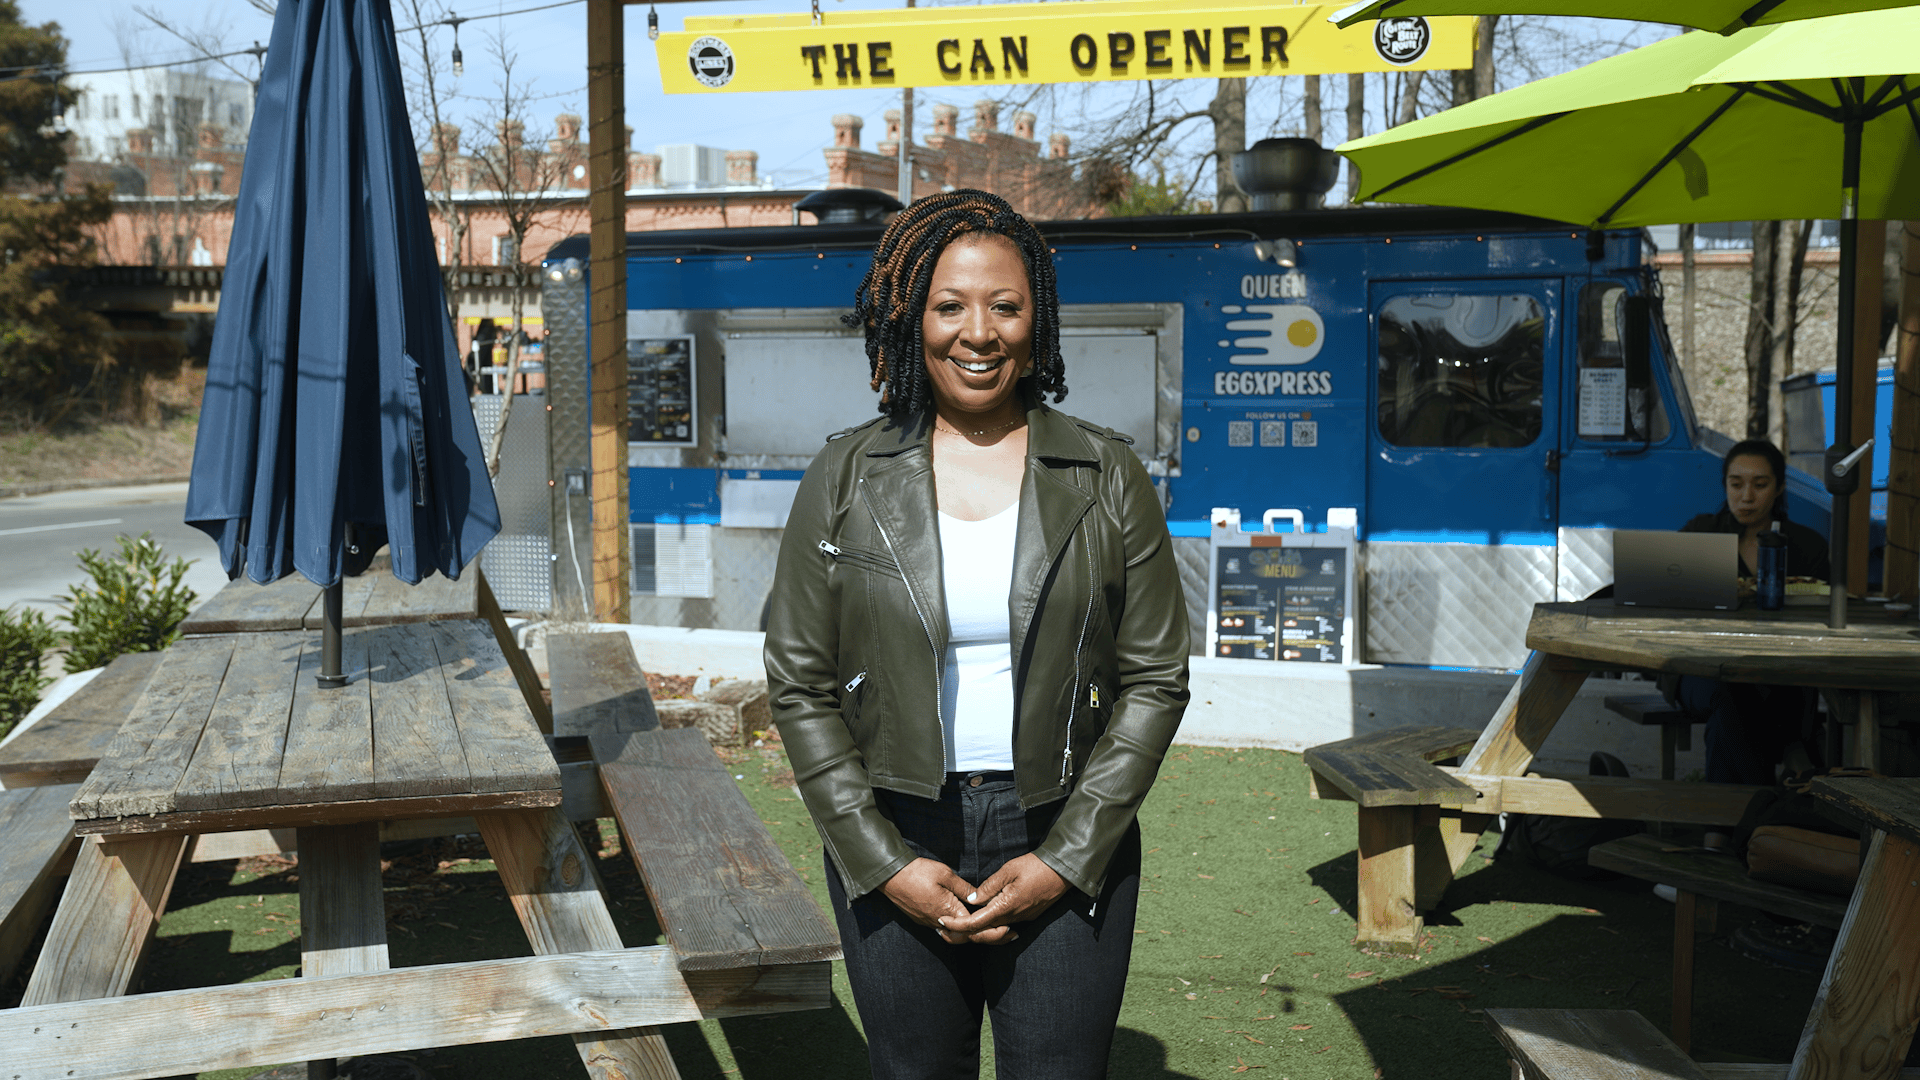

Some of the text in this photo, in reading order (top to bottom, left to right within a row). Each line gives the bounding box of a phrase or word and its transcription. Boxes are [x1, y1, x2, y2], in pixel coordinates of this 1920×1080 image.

[1397, 30, 1419, 41] BELT
[800, 26, 1290, 80] THE CAN OPENER
[1391, 40, 1417, 54] ROUTE
[1241, 274, 1307, 299] QUEEN
[1214, 371, 1332, 396] EGGXPRESS
[1245, 412, 1301, 420] FOLLOW US ON
[1264, 564, 1297, 578] MENU
